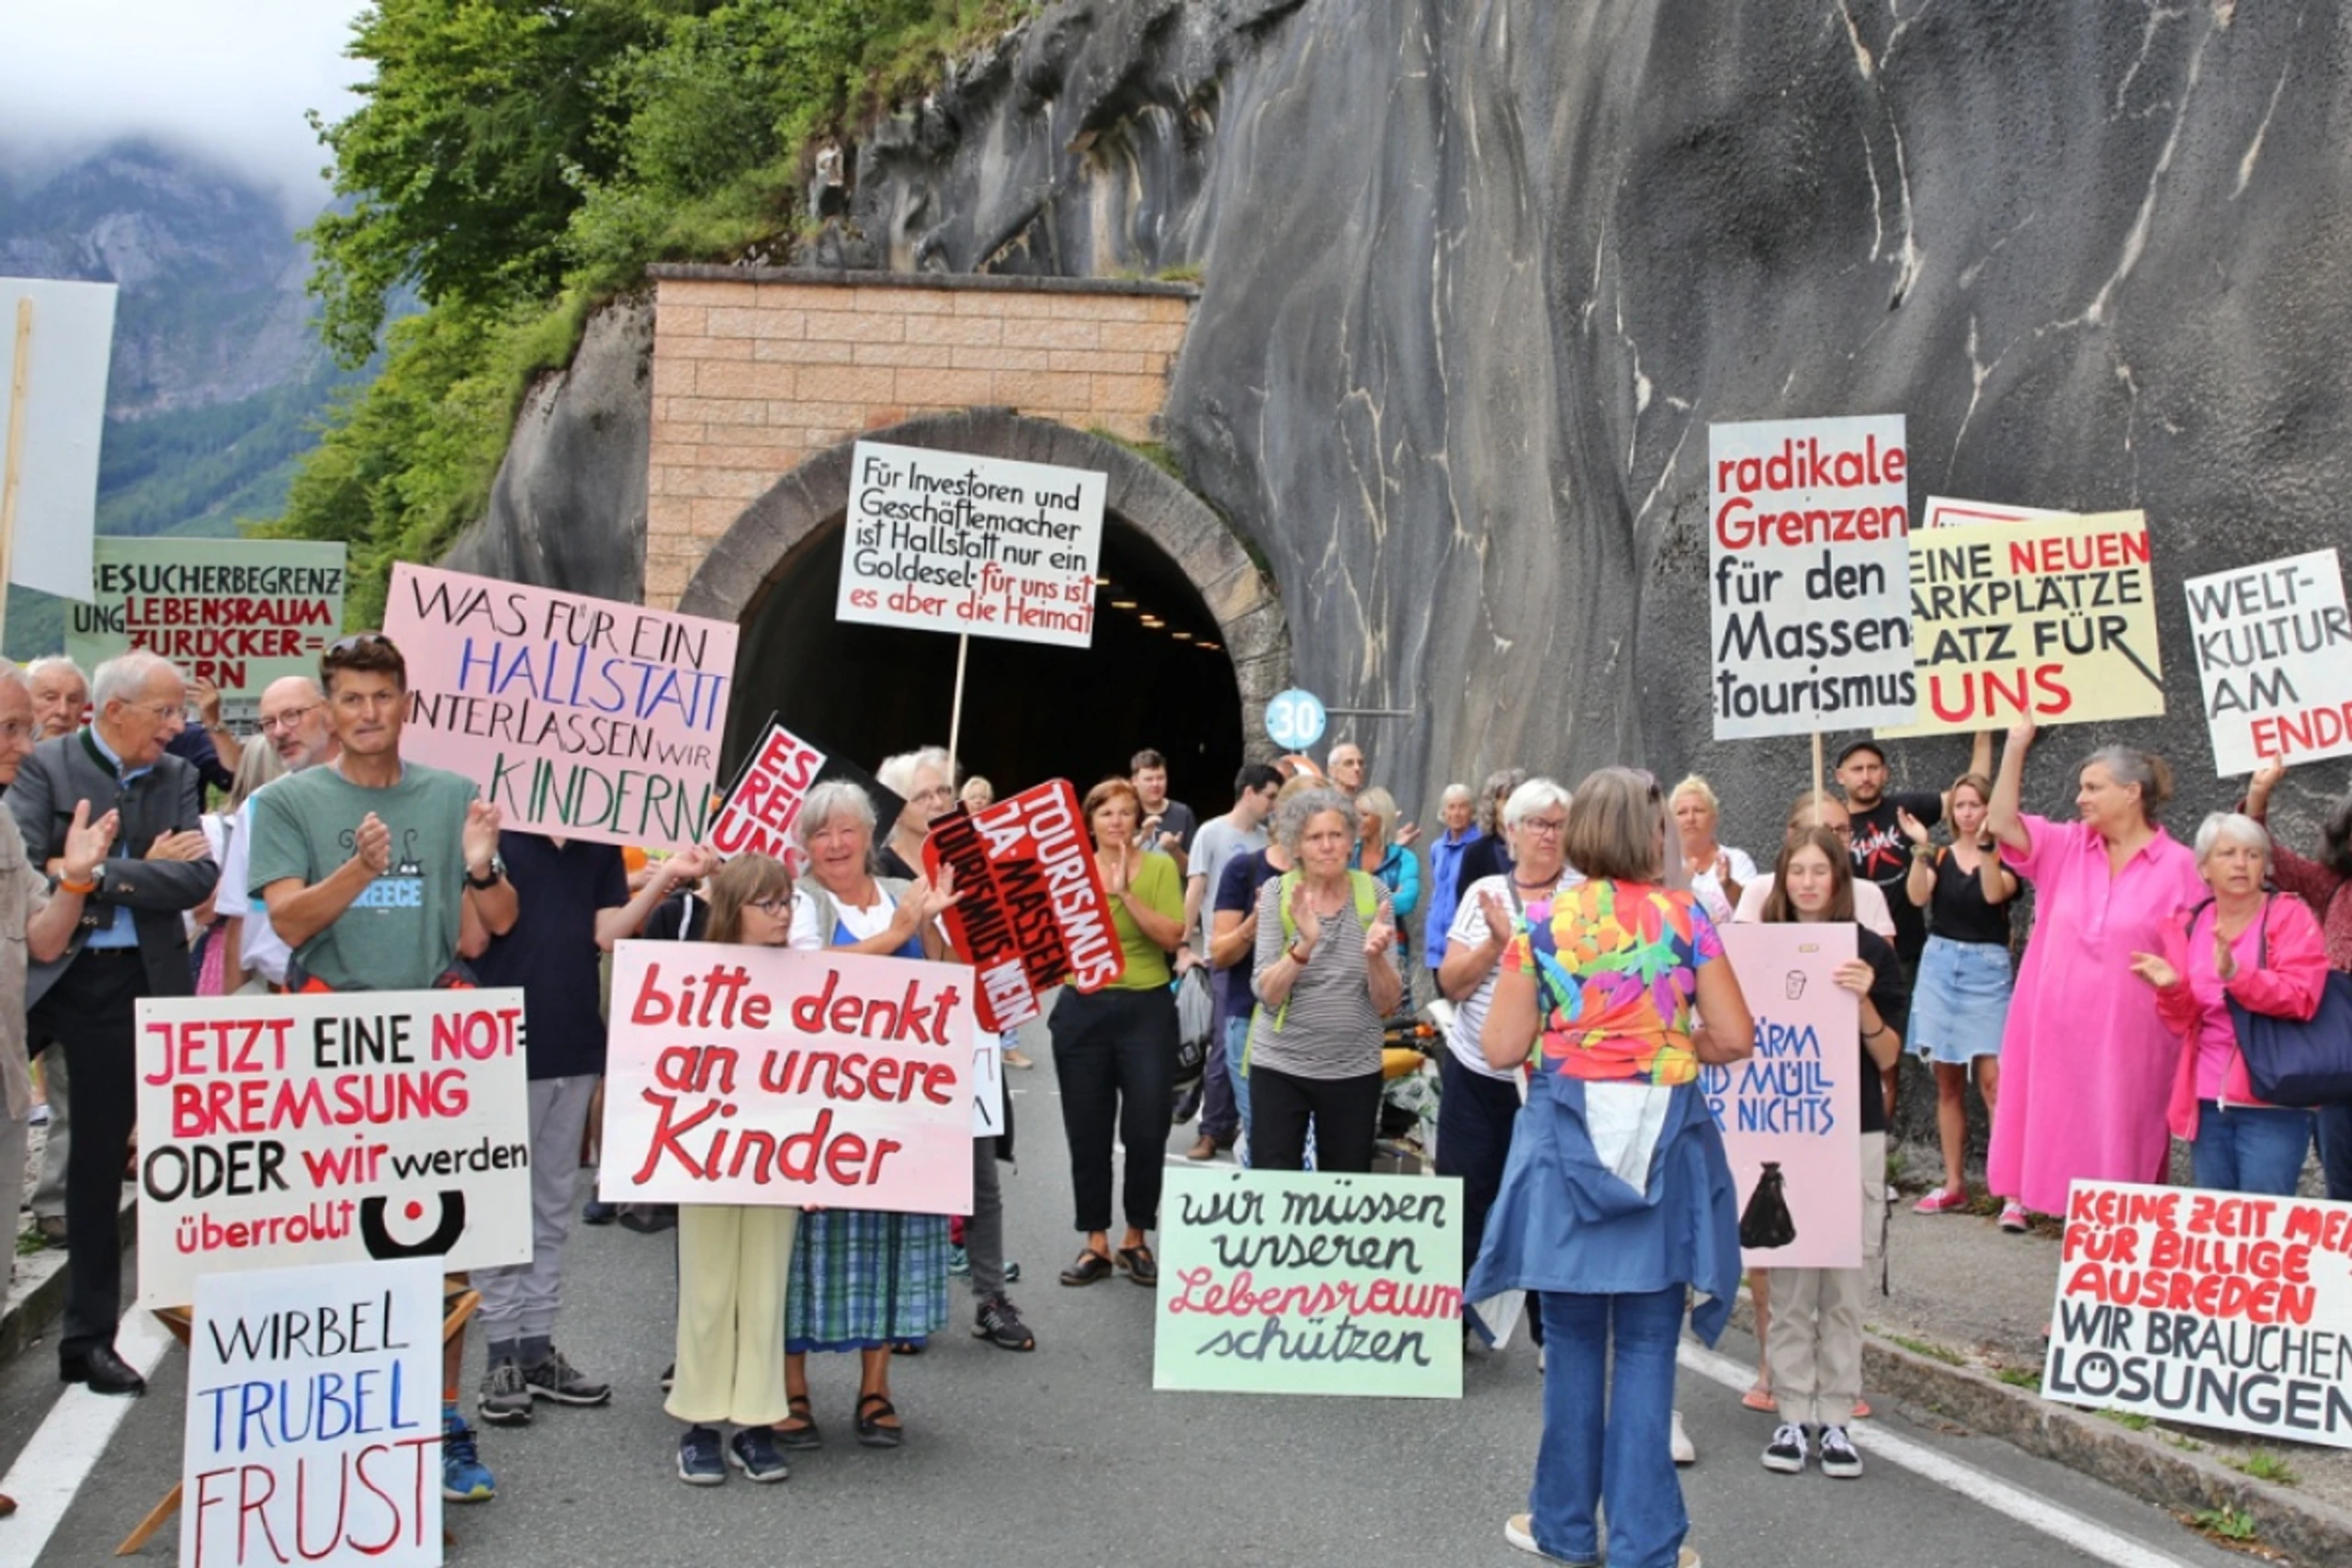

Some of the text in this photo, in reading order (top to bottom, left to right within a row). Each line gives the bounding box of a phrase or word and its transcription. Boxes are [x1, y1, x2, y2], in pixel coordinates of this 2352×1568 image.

[863, 457, 1081, 512] Für Investoren und
[1717, 434, 1907, 493] radikale
[860, 488, 1081, 542] Geschäftemacher
[1715, 497, 1910, 550] Grenzen
[856, 519, 1087, 571] ist Hallstatt nur ein
[1909, 529, 2151, 585] EINE NEUEN
[93, 564, 343, 596] ESUCHERBEGRENZ
[980, 561, 1016, 596] für
[1020, 579, 1057, 600] uns
[1065, 574, 1095, 604] ist
[1715, 550, 1885, 606] für den
[1910, 569, 2143, 622] ARKPLÄTZE
[2188, 566, 2313, 625] WELT-
[74, 596, 333, 634] UNG LEBENSRAUM
[412, 576, 708, 670] WAS FÜR EIN
[850, 583, 1094, 634] es aber die Heimat
[2199, 605, 2352, 671] KULTUR
[458, 637, 729, 733] HALLSTATT
[1929, 663, 2073, 724] UNS
[2210, 667, 2300, 720] AM
[409, 690, 711, 770] NTERLASSEN WIR
[1274, 701, 1317, 739] 30
[758, 730, 819, 792] ES
[489, 751, 711, 846] KINDERN
[734, 768, 804, 836] REI
[1023, 783, 1118, 990] TOURISMUS
[631, 963, 960, 1046] bitte denkt
[979, 956, 1038, 1032] NEIN
[144, 1018, 295, 1087] JETZT
[313, 1014, 414, 1068] EINE
[1753, 1016, 1821, 1059] ÄRM
[172, 1068, 469, 1138] BREMSUNG
[654, 1044, 739, 1095] an
[758, 1048, 956, 1105] unsere
[1738, 1060, 1834, 1097] MÜLL
[631, 1087, 902, 1186] Kinder
[1738, 1097, 1834, 1136] NICHTS
[143, 1134, 527, 1202] ODER wir werden
[175, 1199, 356, 1255] überrollt
[1177, 1172, 1445, 1228] wir müssen
[2070, 1190, 2180, 1231] KEINE
[2187, 1195, 2277, 1238] ZEIT
[1211, 1234, 1422, 1275] unseren
[2063, 1224, 2312, 1284] FÜR BILLIGE
[1168, 1266, 1464, 1319] Lebensraum
[2065, 1261, 2316, 1325] AUSREDEN
[209, 1289, 410, 1364] WIRBEL
[1194, 1314, 1431, 1367] schützen
[2061, 1299, 2352, 1382] WIR BRAUCHEN
[197, 1359, 419, 1452] TRUBEL
[2050, 1347, 2352, 1433] LÖSUNGEN
[195, 1437, 443, 1568] FRUST
